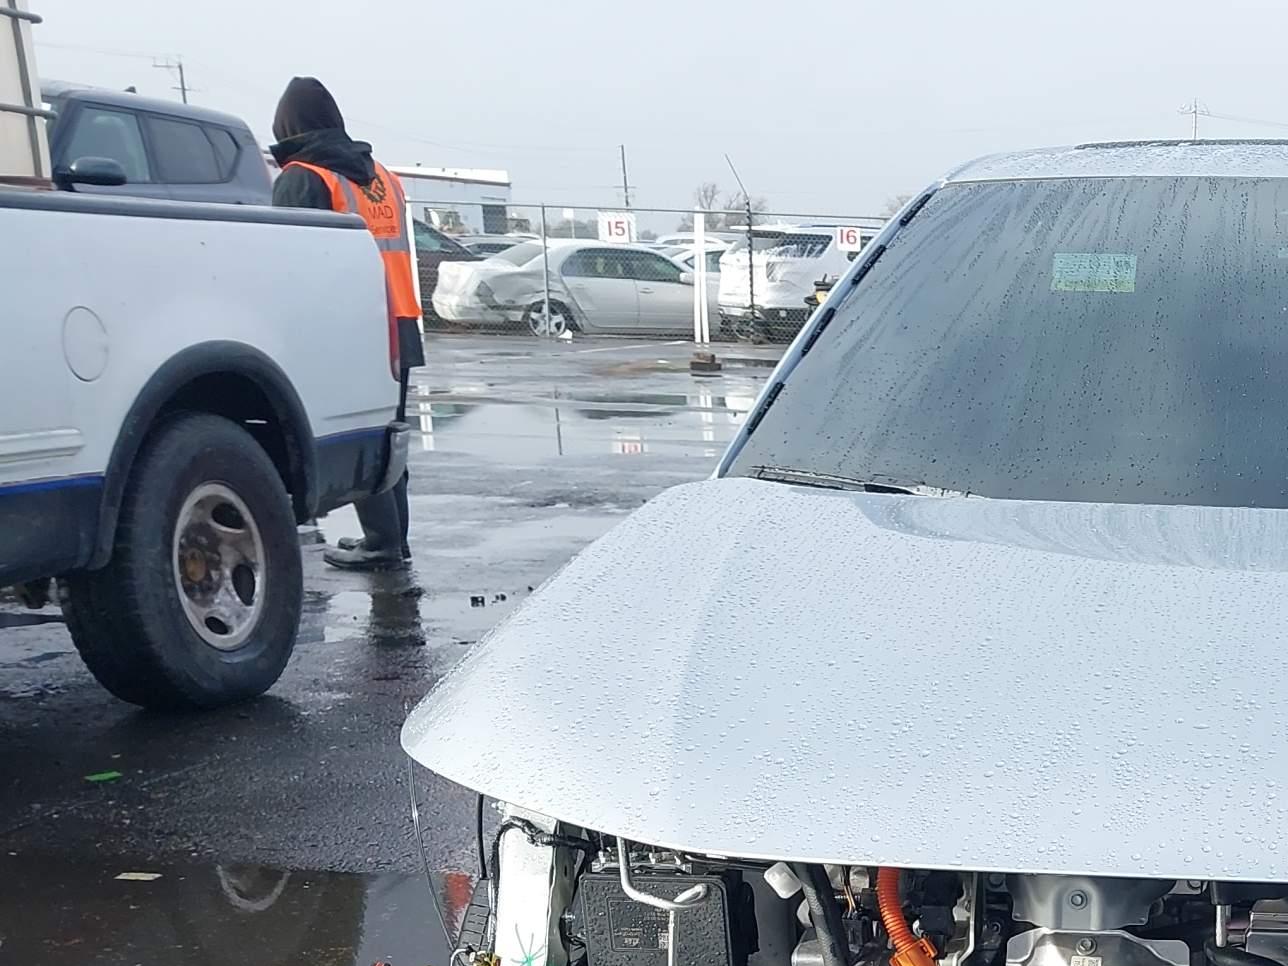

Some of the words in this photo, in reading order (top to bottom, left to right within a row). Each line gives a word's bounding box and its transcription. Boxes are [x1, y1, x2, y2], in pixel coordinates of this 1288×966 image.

[368, 205, 394, 219] MAD
[607, 221, 626, 237] 15
[840, 229, 858, 245] 16
